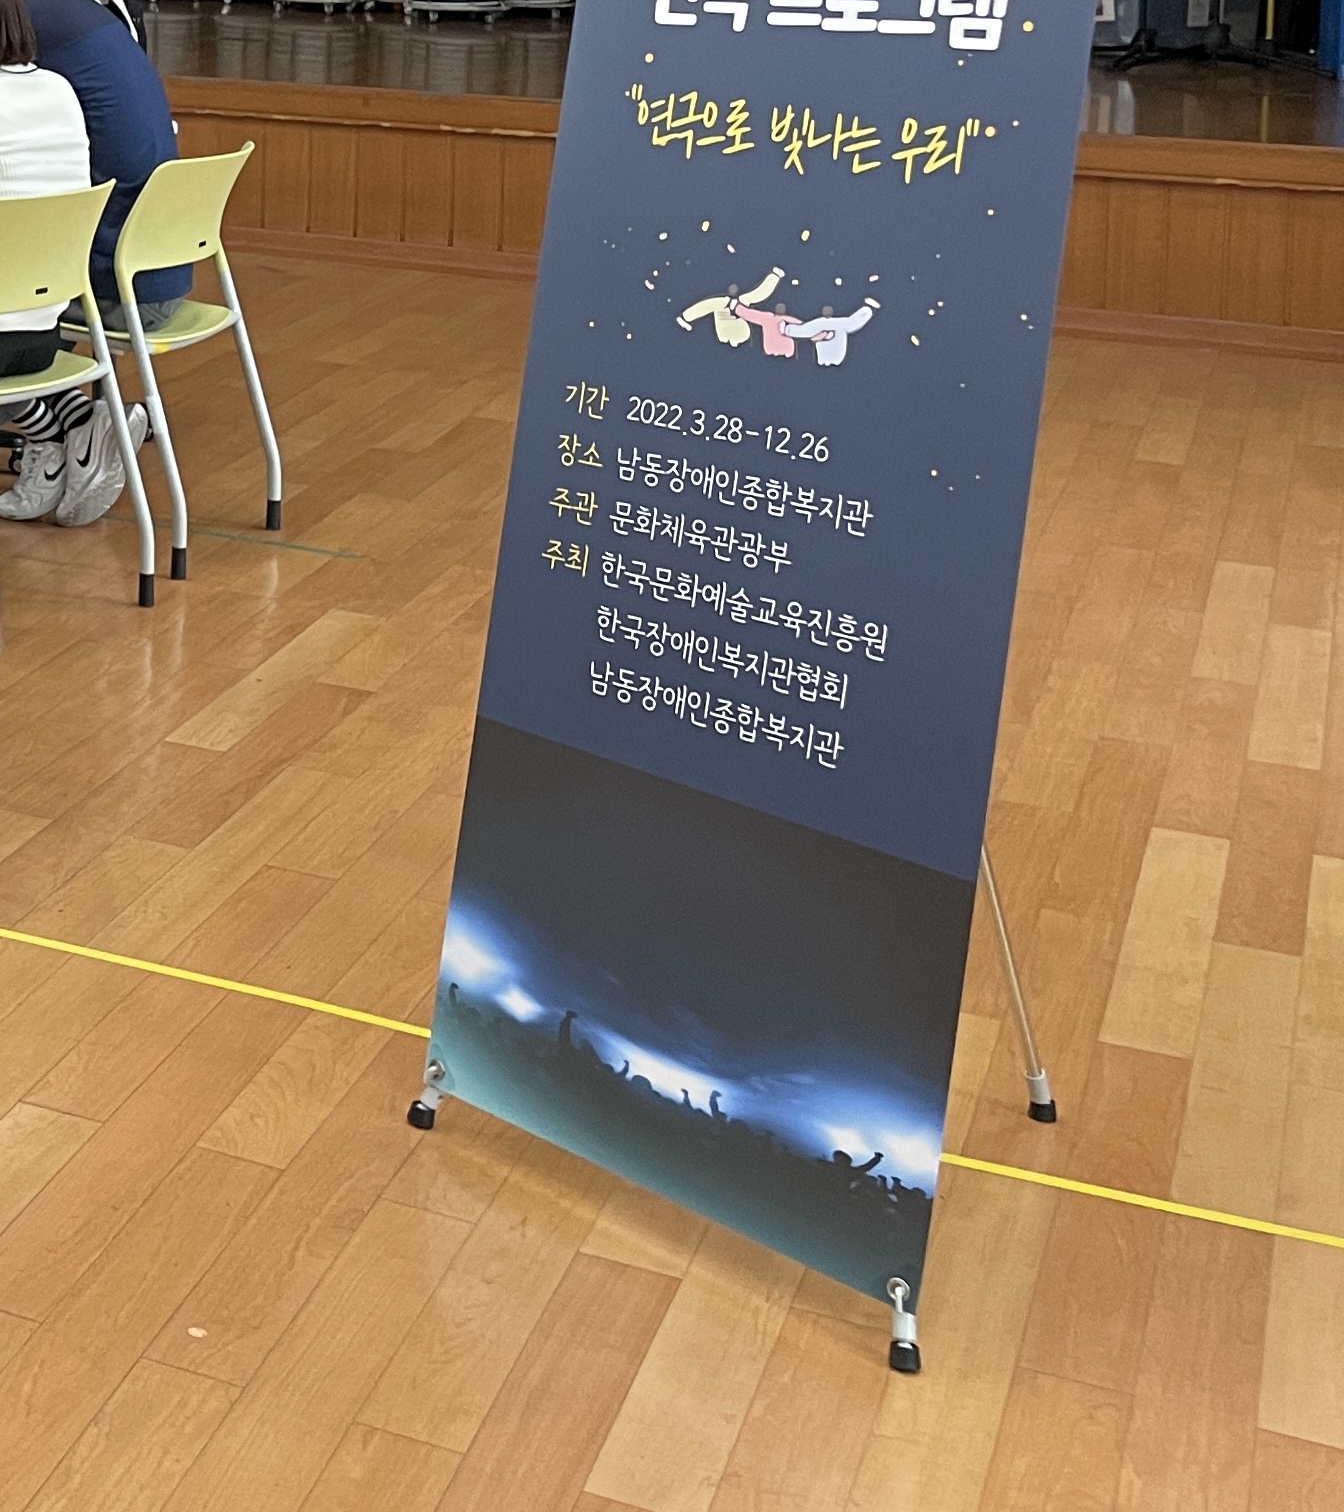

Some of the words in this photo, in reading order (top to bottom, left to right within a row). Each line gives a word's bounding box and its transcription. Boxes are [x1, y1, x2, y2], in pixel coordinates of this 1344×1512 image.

[771, 105, 881, 174] 빛나는
[566, 382, 609, 419] 기간
[627, 397, 828, 461] 2022.3.28-12.26
[549, 488, 598, 525] 주관
[609, 502, 791, 573] 문화체육관광부
[558, 434, 602, 467] 장소
[618, 448, 873, 536] 남동장애인종합복지관
[542, 540, 588, 577] 주최
[602, 552, 887, 661] 한국문화예술교육진흥원
[598, 606, 847, 709] 한국장애인복지관협회
[591, 662, 844, 768] 남동장애인종합복지관
